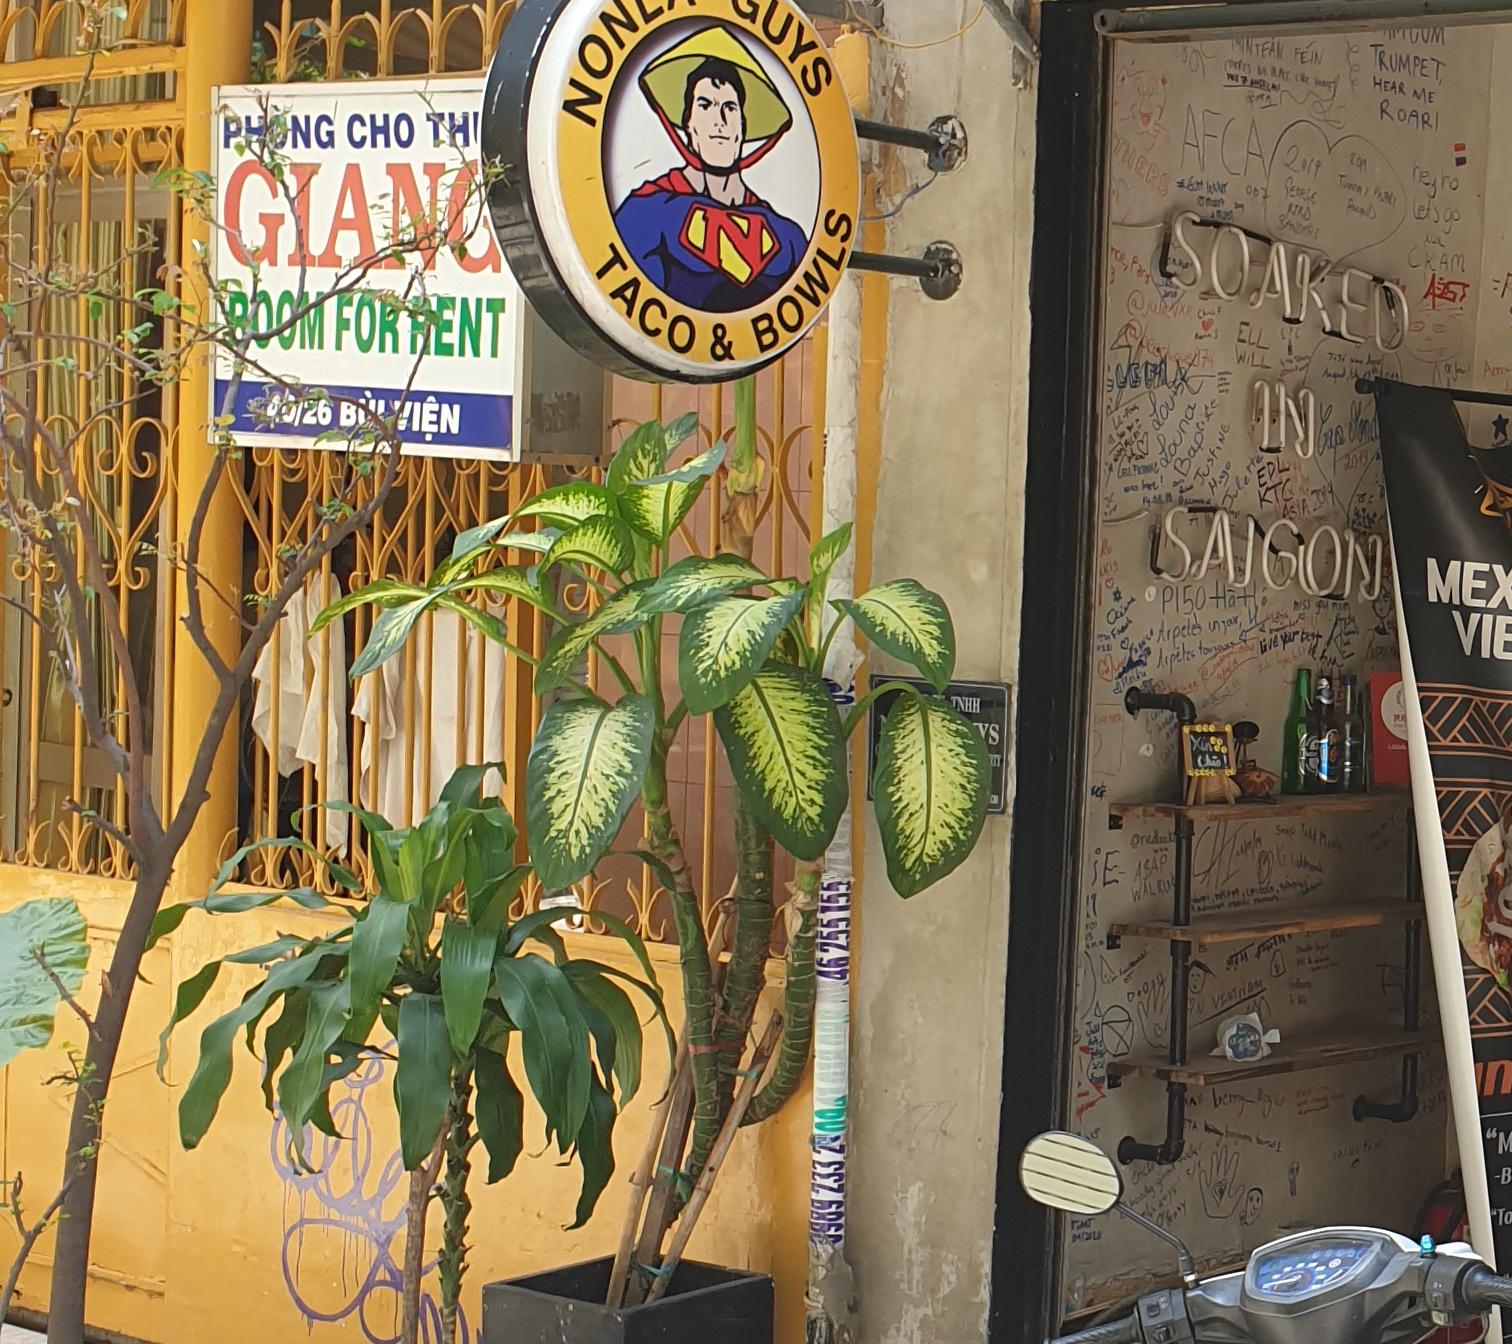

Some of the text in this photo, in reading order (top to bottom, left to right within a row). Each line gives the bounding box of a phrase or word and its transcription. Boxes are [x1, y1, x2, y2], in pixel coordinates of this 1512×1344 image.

[1370, 44, 1446, 86] TRUMPET,
[1373, 76, 1435, 104] HEAR ME
[346, 113, 415, 150] CHO
[1181, 104, 1267, 177] AFCA
[223, 159, 502, 274] GIANG
[596, 208, 852, 362] TACO & BOWLS
[1170, 209, 1408, 353] SOAKED
[335, 290, 399, 355] FOR
[410, 294, 506, 359] RENT
[396, 395, 460, 442] VIỆN
[1253, 380, 1315, 458] IN
[1158, 506, 1383, 601] SAIGON
